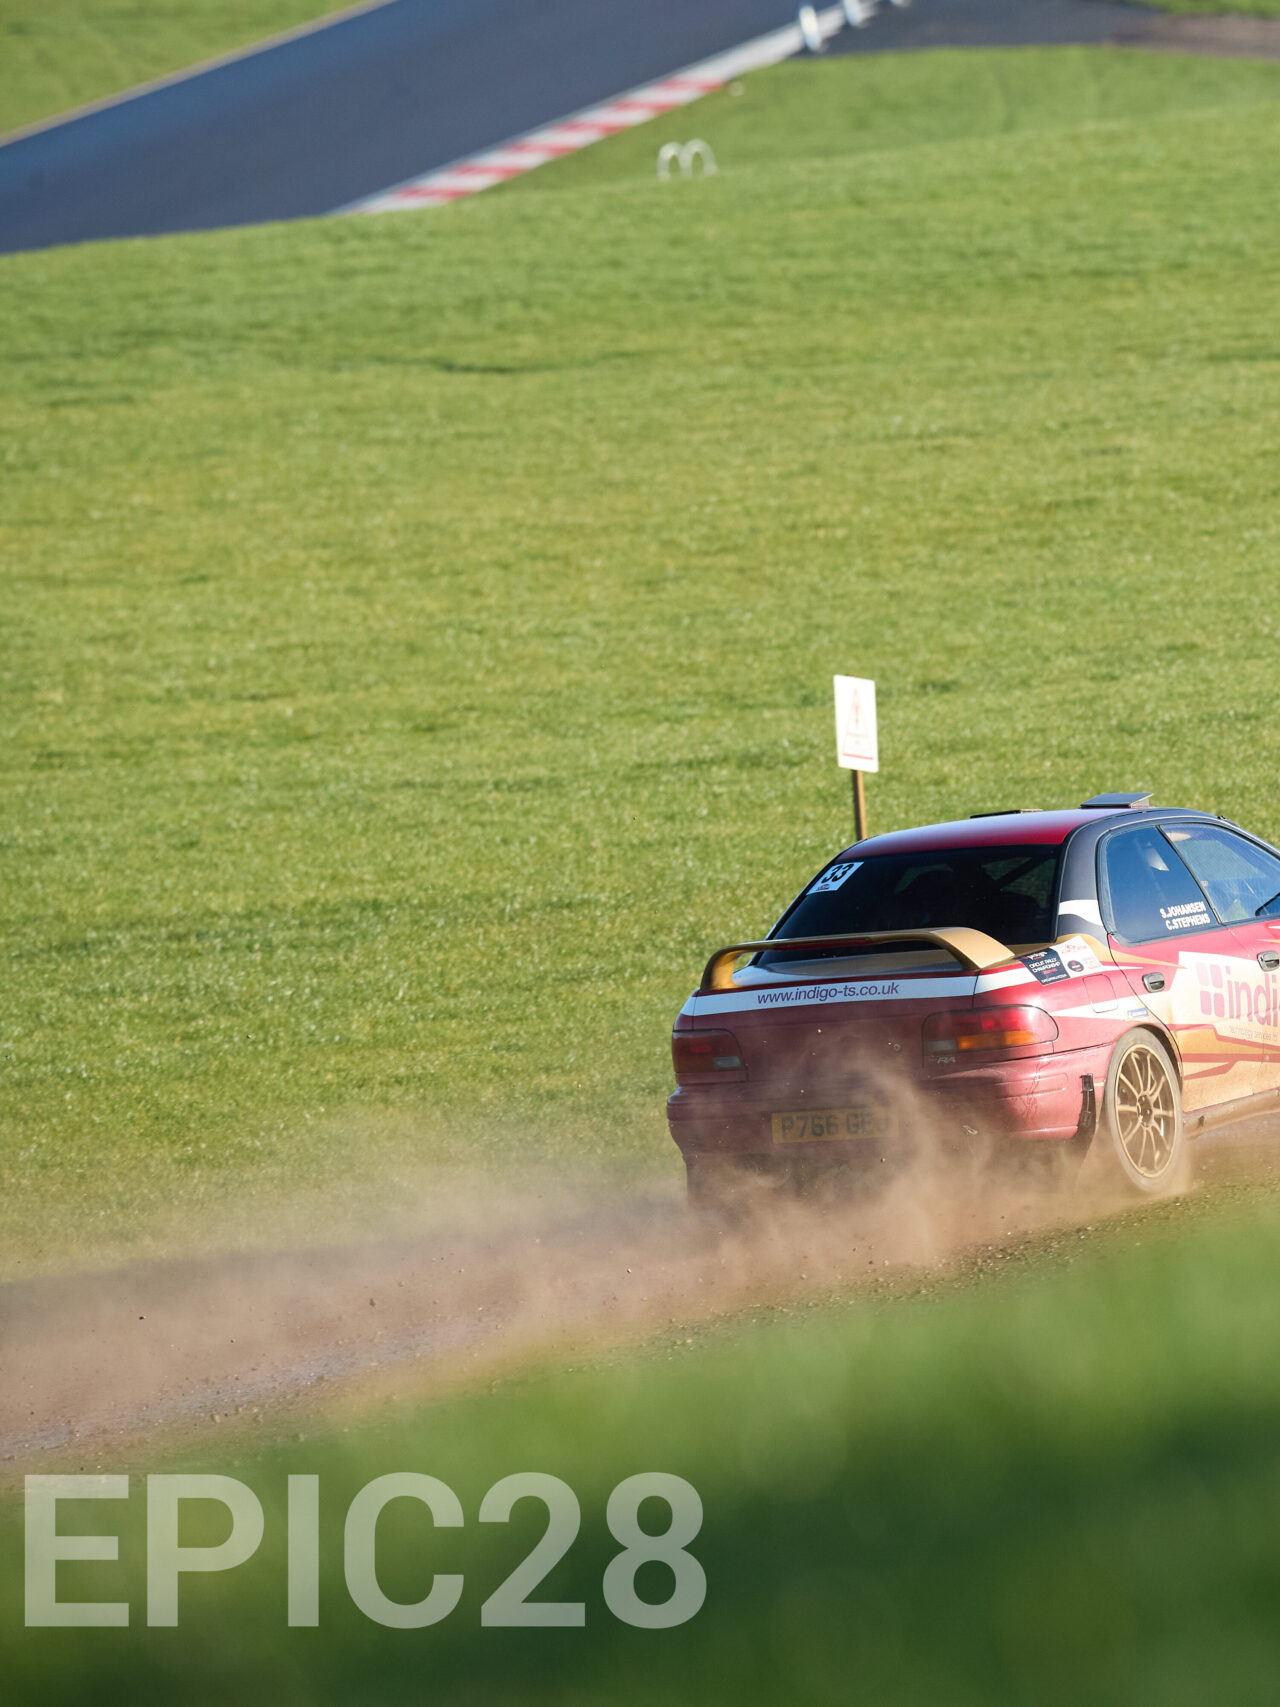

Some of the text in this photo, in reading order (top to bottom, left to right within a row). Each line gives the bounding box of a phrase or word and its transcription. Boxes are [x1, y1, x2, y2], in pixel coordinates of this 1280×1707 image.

[821, 863, 855, 884] 33
[1160, 901, 1206, 919] S.JOHANSEN
[1165, 913, 1210, 931] C.STEPHENS
[757, 982, 900, 1005] www.indigo-ts.co.uk
[781, 1114, 840, 1139] P766
